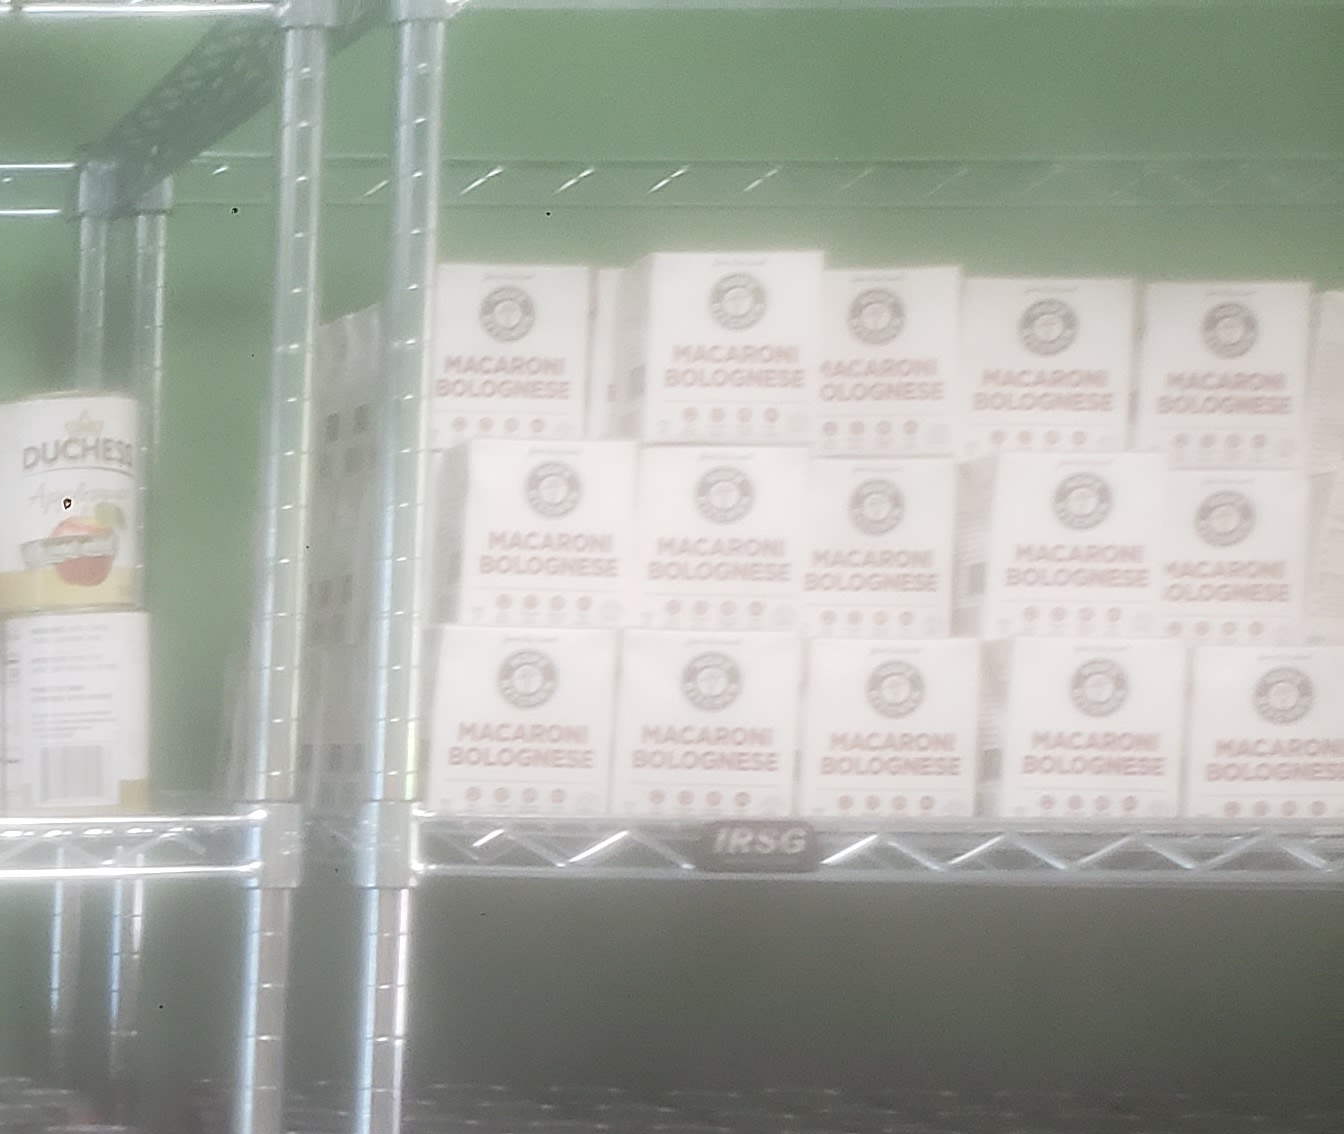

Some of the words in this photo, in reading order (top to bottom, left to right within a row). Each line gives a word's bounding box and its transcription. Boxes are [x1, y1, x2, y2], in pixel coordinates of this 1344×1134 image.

[672, 345, 799, 364] MACARONI
[444, 356, 565, 375] MACARONI
[664, 369, 805, 389] BOLOGNESE
[981, 368, 1109, 388] MACARONI
[1167, 372, 1287, 391] MACARONI
[436, 379, 571, 399] BOLOGNESE
[820, 382, 944, 402] OLOGNESE
[973, 392, 1114, 412] BOLOGNESE
[1156, 395, 1293, 415] BOLOGNESE
[488, 531, 612, 552] MACARONI
[656, 537, 785, 558] MACARONI
[813, 548, 934, 569] MACARONI
[1015, 544, 1145, 565] MACARONI
[479, 555, 619, 577] BOLOGNESE
[647, 561, 792, 582] BOLOGNESE
[803, 572, 939, 593] BOLOGNESE
[1005, 567, 1150, 588] BOLOGNESE
[1162, 583, 1293, 602] OLOGNESE
[458, 722, 589, 744] MACARONI
[641, 725, 774, 747] MACARONI
[828, 732, 956, 753] MACARONI
[1031, 731, 1161, 751] MACARONI
[449, 746, 595, 769] BOLOGNESE
[631, 749, 780, 772] BOLOGNESE
[819, 756, 962, 777] BOLOGNESE
[1022, 755, 1167, 776] BOLOGNESE
[714, 828, 807, 854] IRSG
